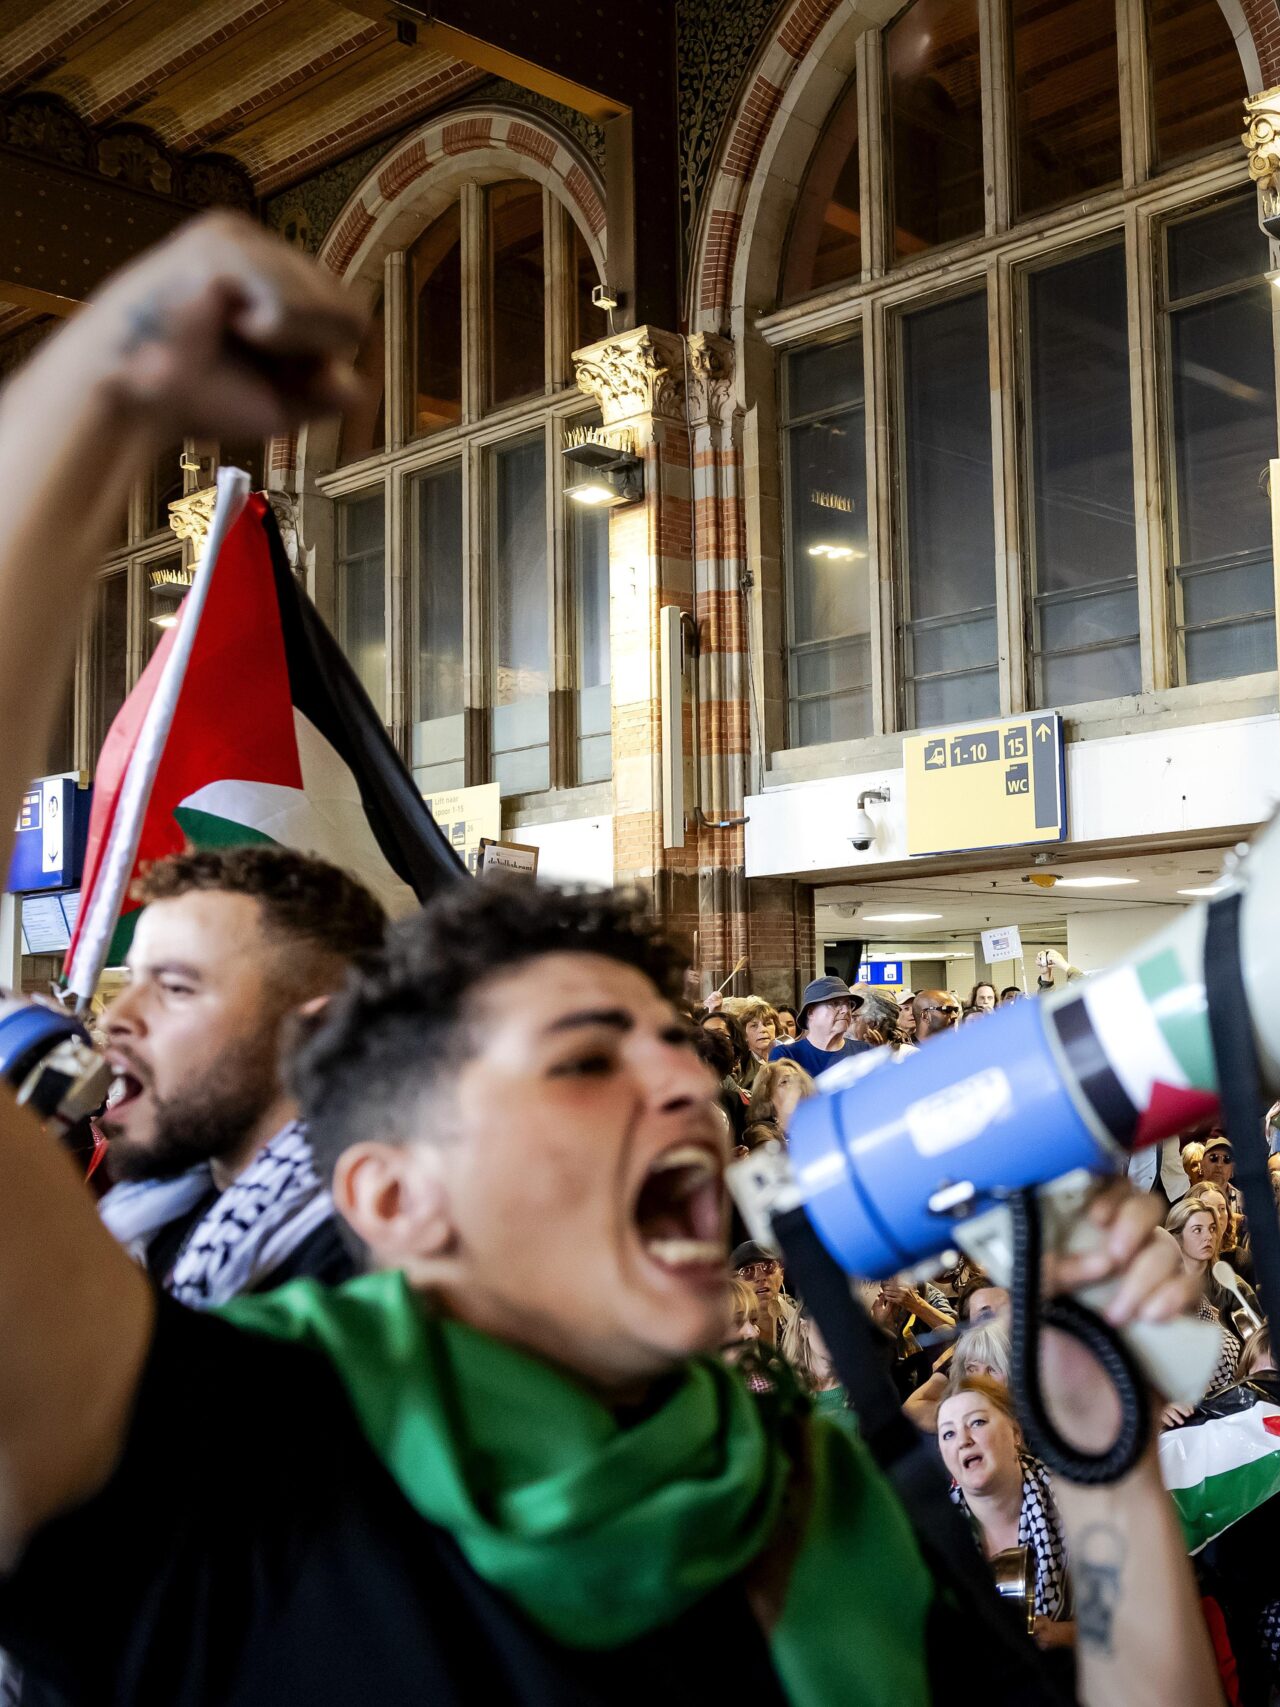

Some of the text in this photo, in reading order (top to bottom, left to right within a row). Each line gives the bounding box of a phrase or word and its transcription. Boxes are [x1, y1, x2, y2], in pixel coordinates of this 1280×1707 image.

[953, 743, 987, 764] 1-10
[1007, 738, 1025, 757] 15
[1007, 779, 1028, 793] WC
